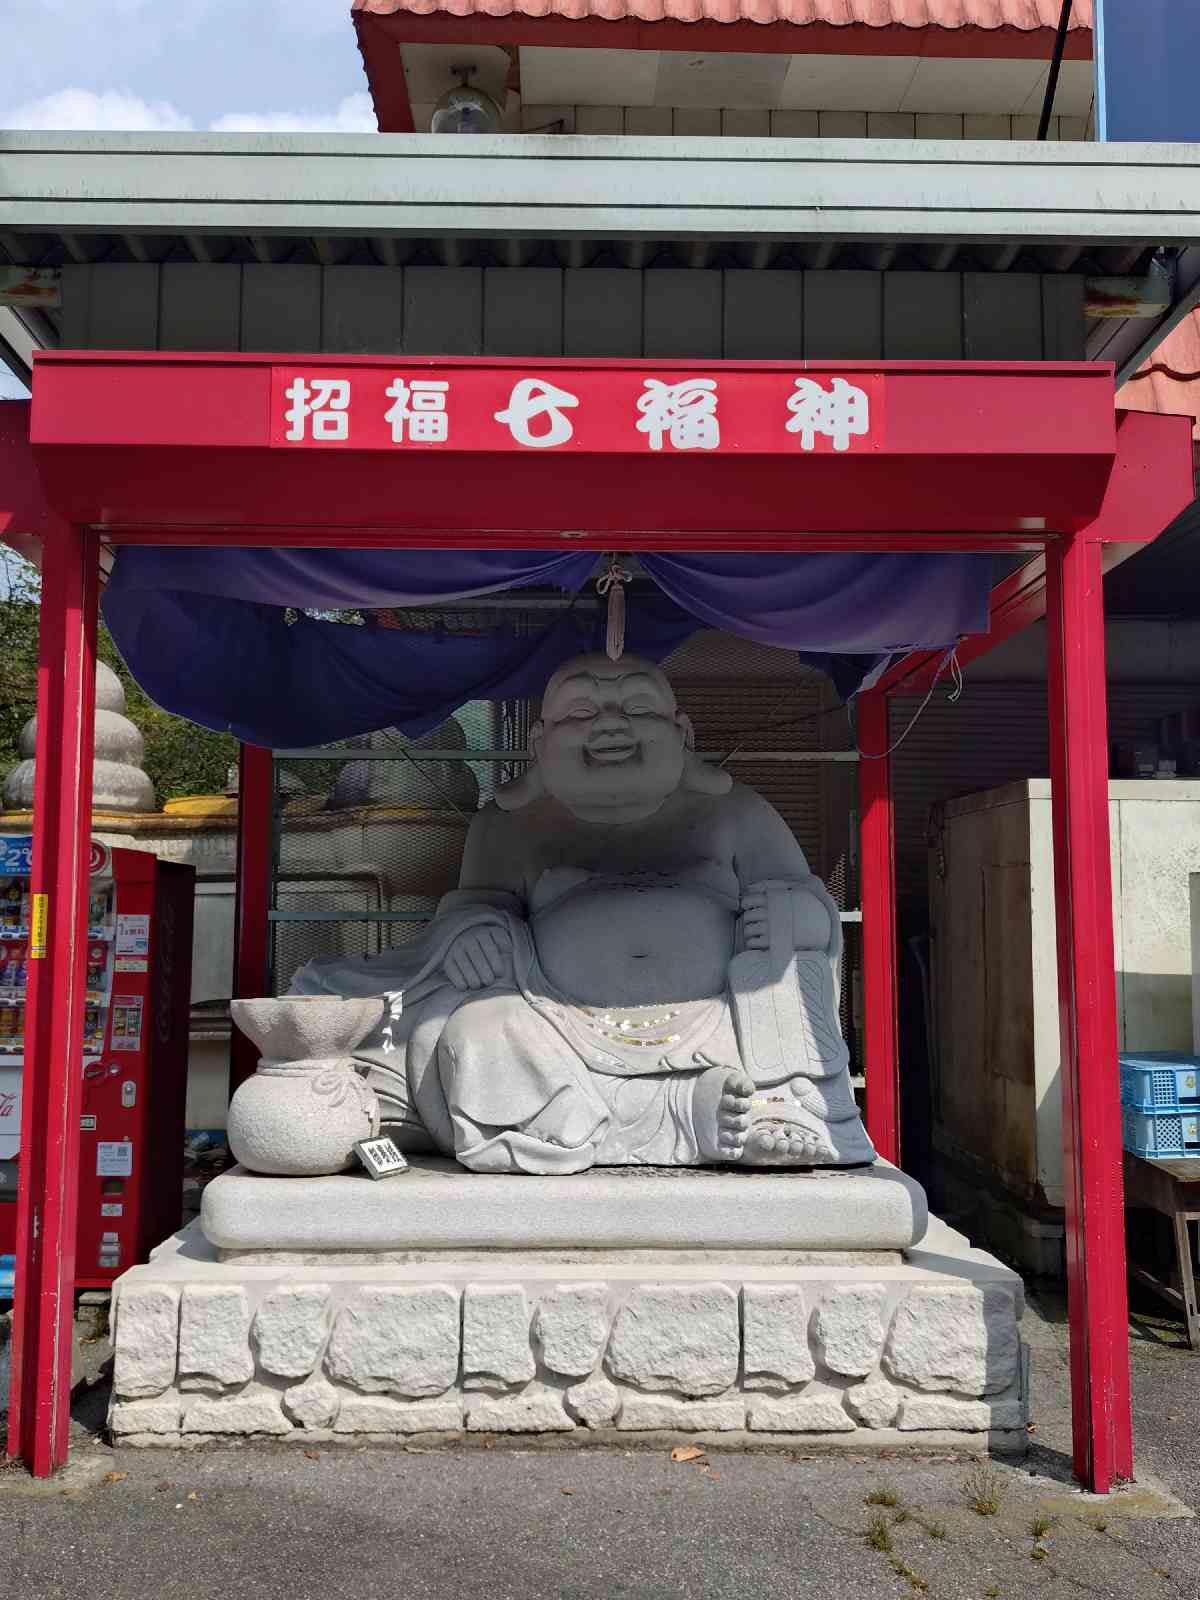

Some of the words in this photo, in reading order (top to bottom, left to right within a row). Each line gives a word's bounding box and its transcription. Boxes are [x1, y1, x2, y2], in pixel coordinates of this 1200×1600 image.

[285, 377, 869, 451] 招福七福神
